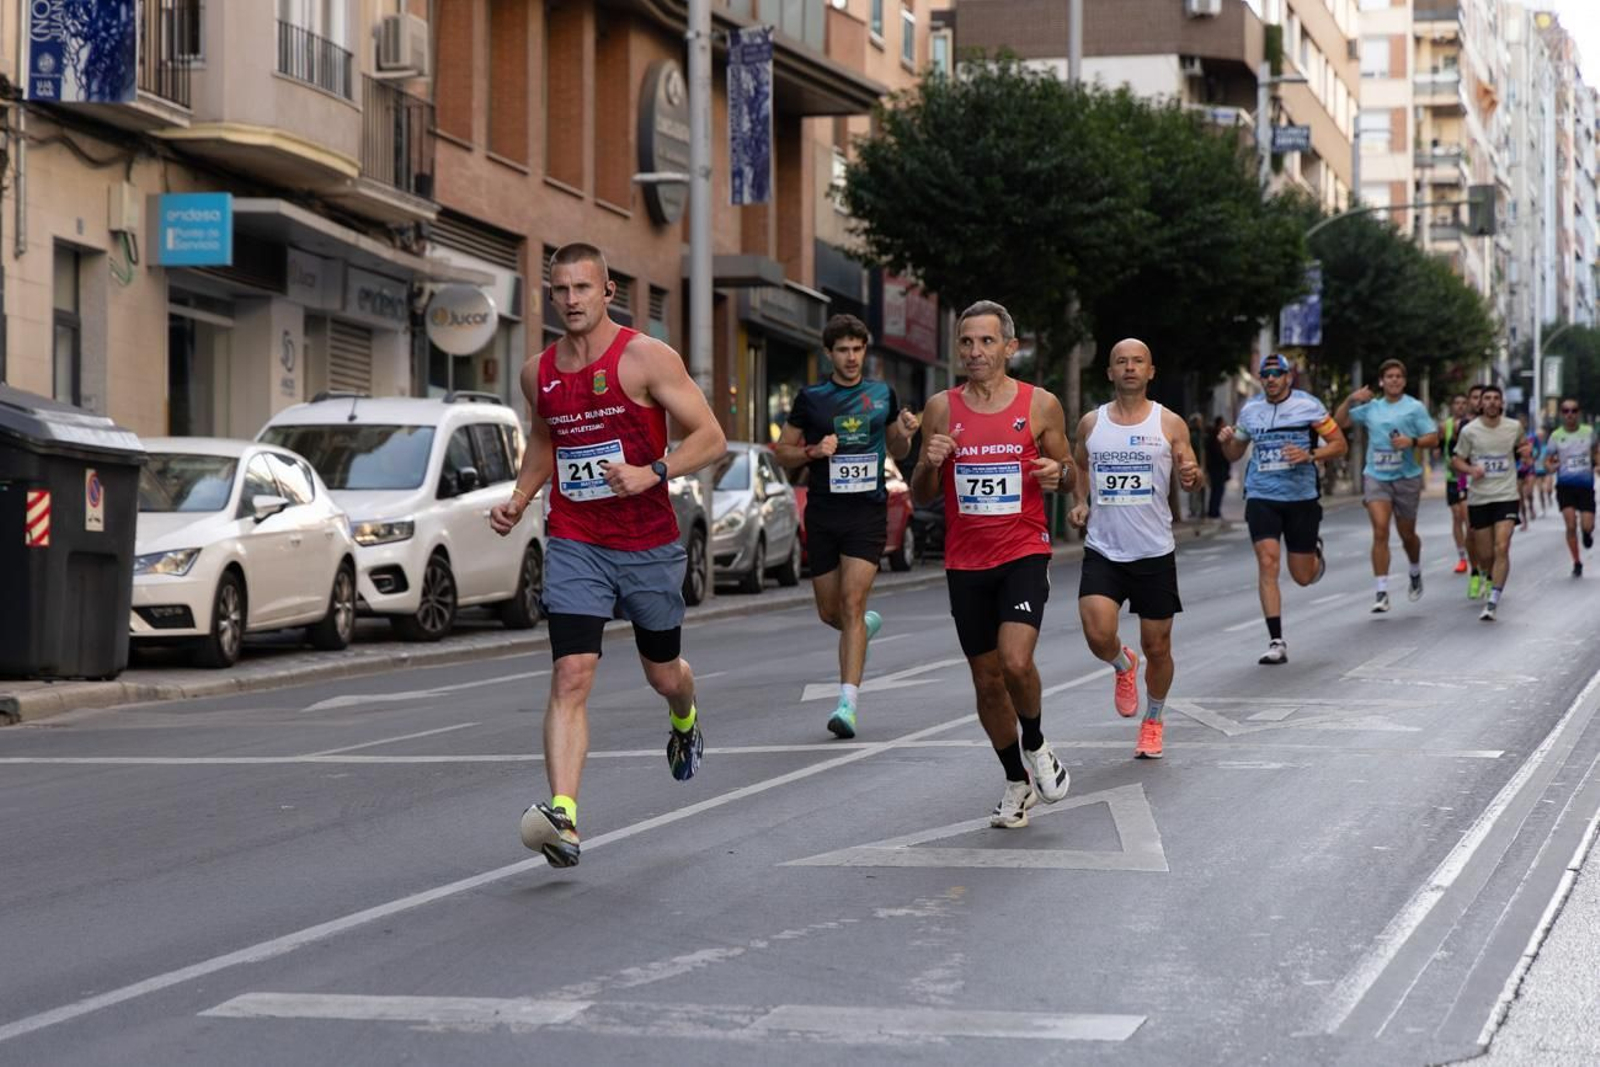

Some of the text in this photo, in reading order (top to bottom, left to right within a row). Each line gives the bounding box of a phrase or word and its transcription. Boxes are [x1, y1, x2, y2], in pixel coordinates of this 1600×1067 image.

[585, 406, 625, 418] RUNNING
[955, 444, 1024, 458] SAN PEDRO
[839, 465, 869, 478] 931
[966, 477, 1007, 495] 751
[1105, 475, 1142, 489] 973
